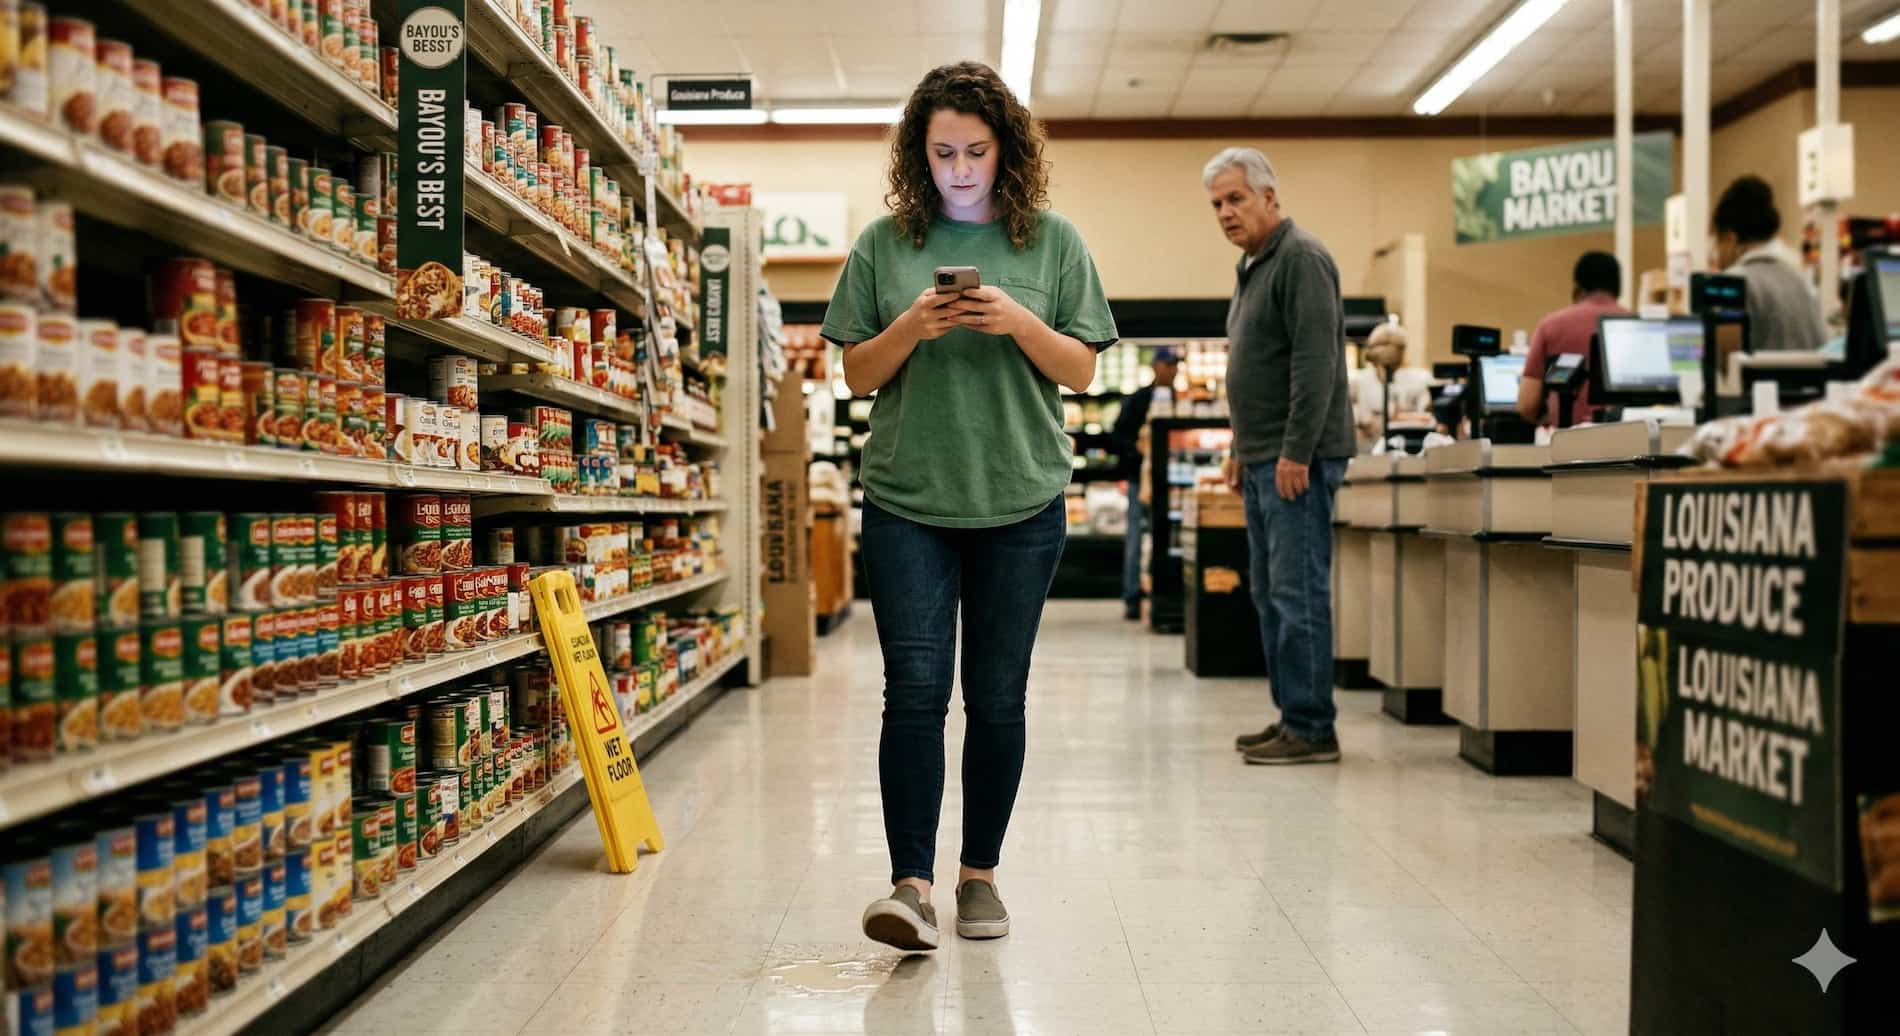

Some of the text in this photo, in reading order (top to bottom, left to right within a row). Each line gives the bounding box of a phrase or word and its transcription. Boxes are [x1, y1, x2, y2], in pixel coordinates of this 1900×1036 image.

[406, 24, 460, 39] BAYOU'S
[413, 39, 453, 53] BESST
[417, 89, 446, 230] BAYOU'S BEST
[1510, 148, 1614, 198] BAYOU
[1503, 186, 1617, 233] MARKET
[1662, 492, 1817, 558] LOUISIANA
[1662, 558, 1805, 637] PRODUCE
[1677, 644, 1824, 736] LOUISIANA
[603, 736, 623, 759] WET
[607, 757, 635, 784] FLOOR
[1683, 707, 1810, 807] MARKET
